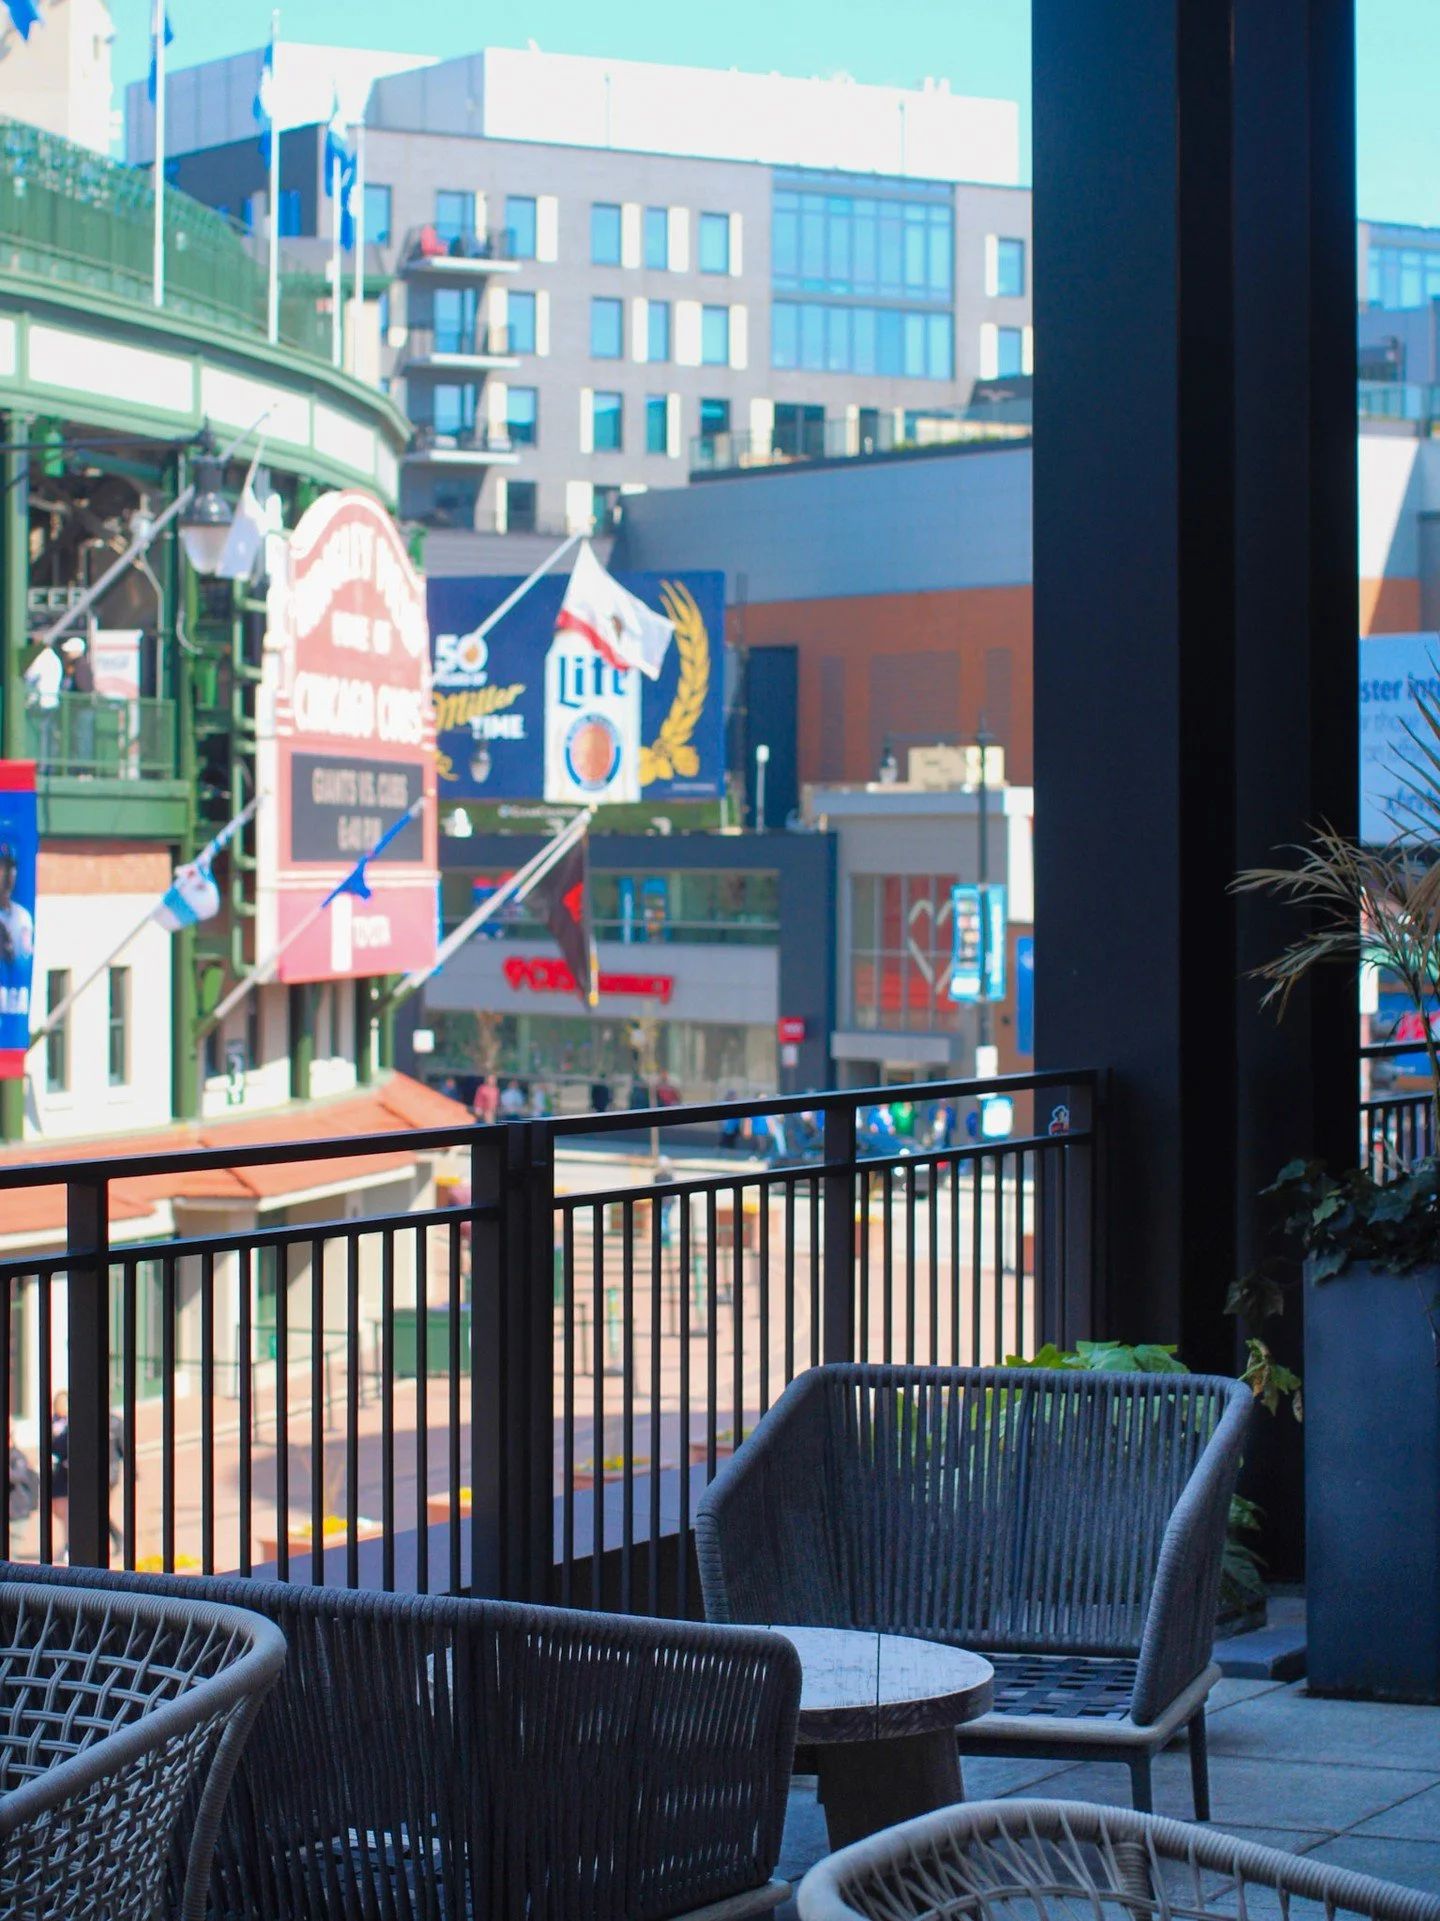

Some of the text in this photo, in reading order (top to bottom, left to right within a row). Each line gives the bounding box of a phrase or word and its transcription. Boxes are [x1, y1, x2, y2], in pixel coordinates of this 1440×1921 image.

[435, 634, 488, 672] 50
[295, 671, 422, 744] CHICAGO CUBS
[432, 684, 526, 735] Miller
[1361, 678, 1402, 703] ster
